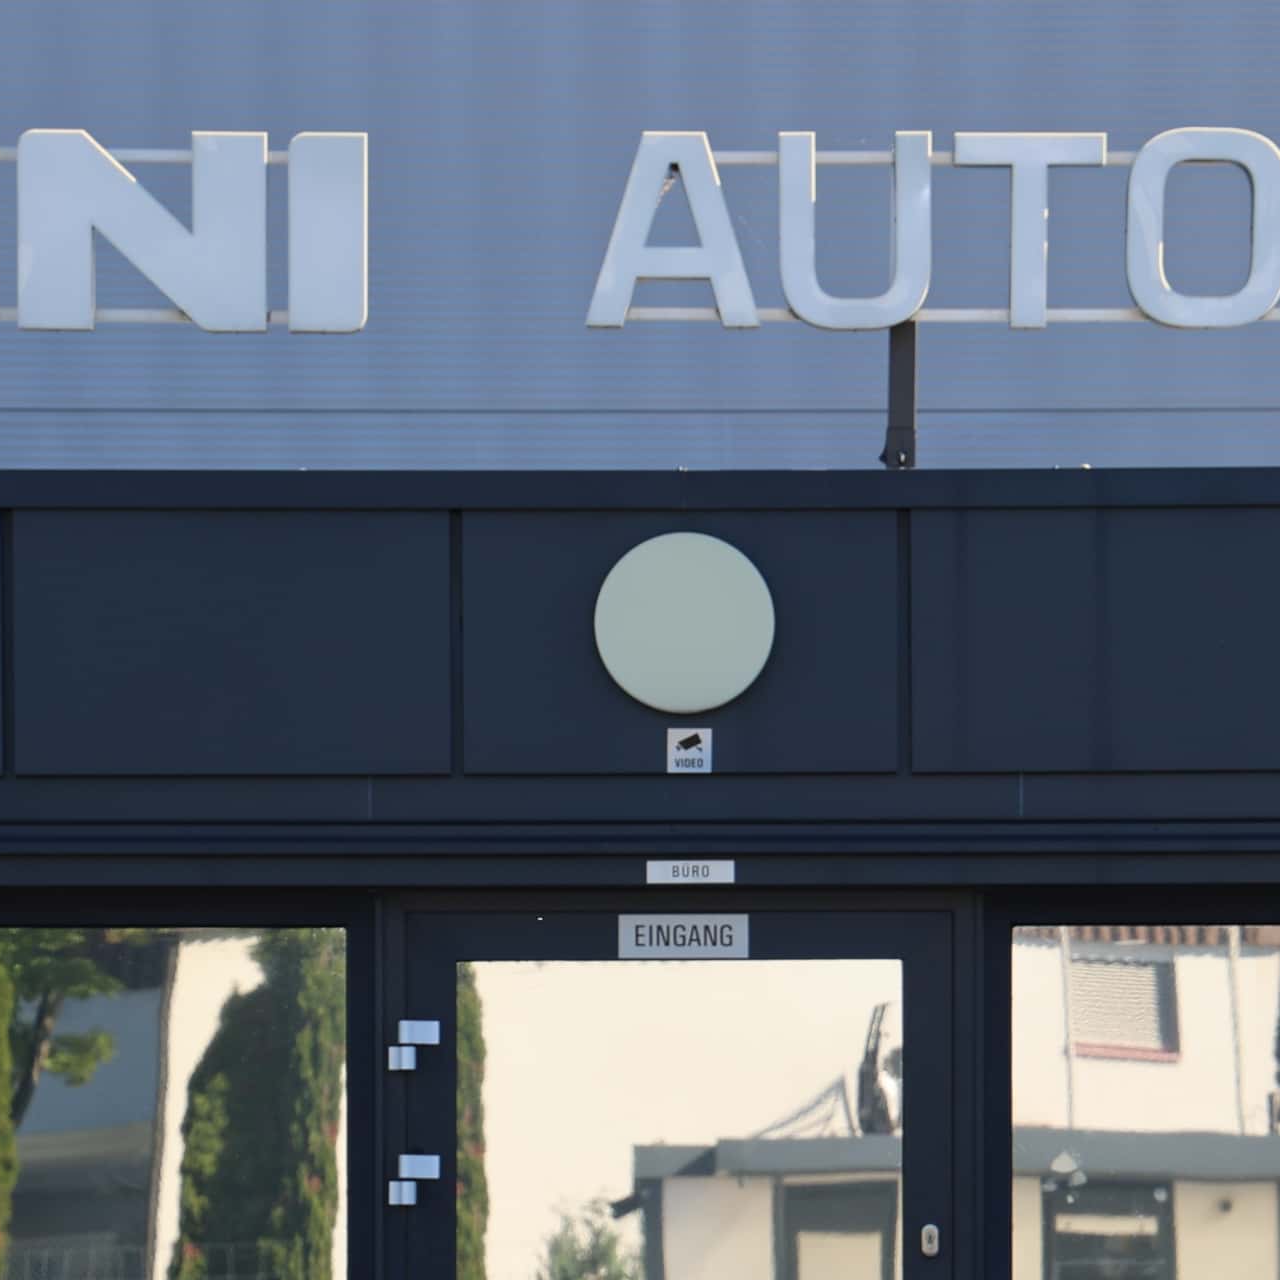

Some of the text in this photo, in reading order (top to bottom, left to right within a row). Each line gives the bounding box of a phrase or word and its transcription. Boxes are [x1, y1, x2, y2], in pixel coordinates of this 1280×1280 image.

[673, 757, 704, 769] VIDEO
[671, 862, 711, 879] BÜRO
[634, 923, 734, 948] EINGANG
